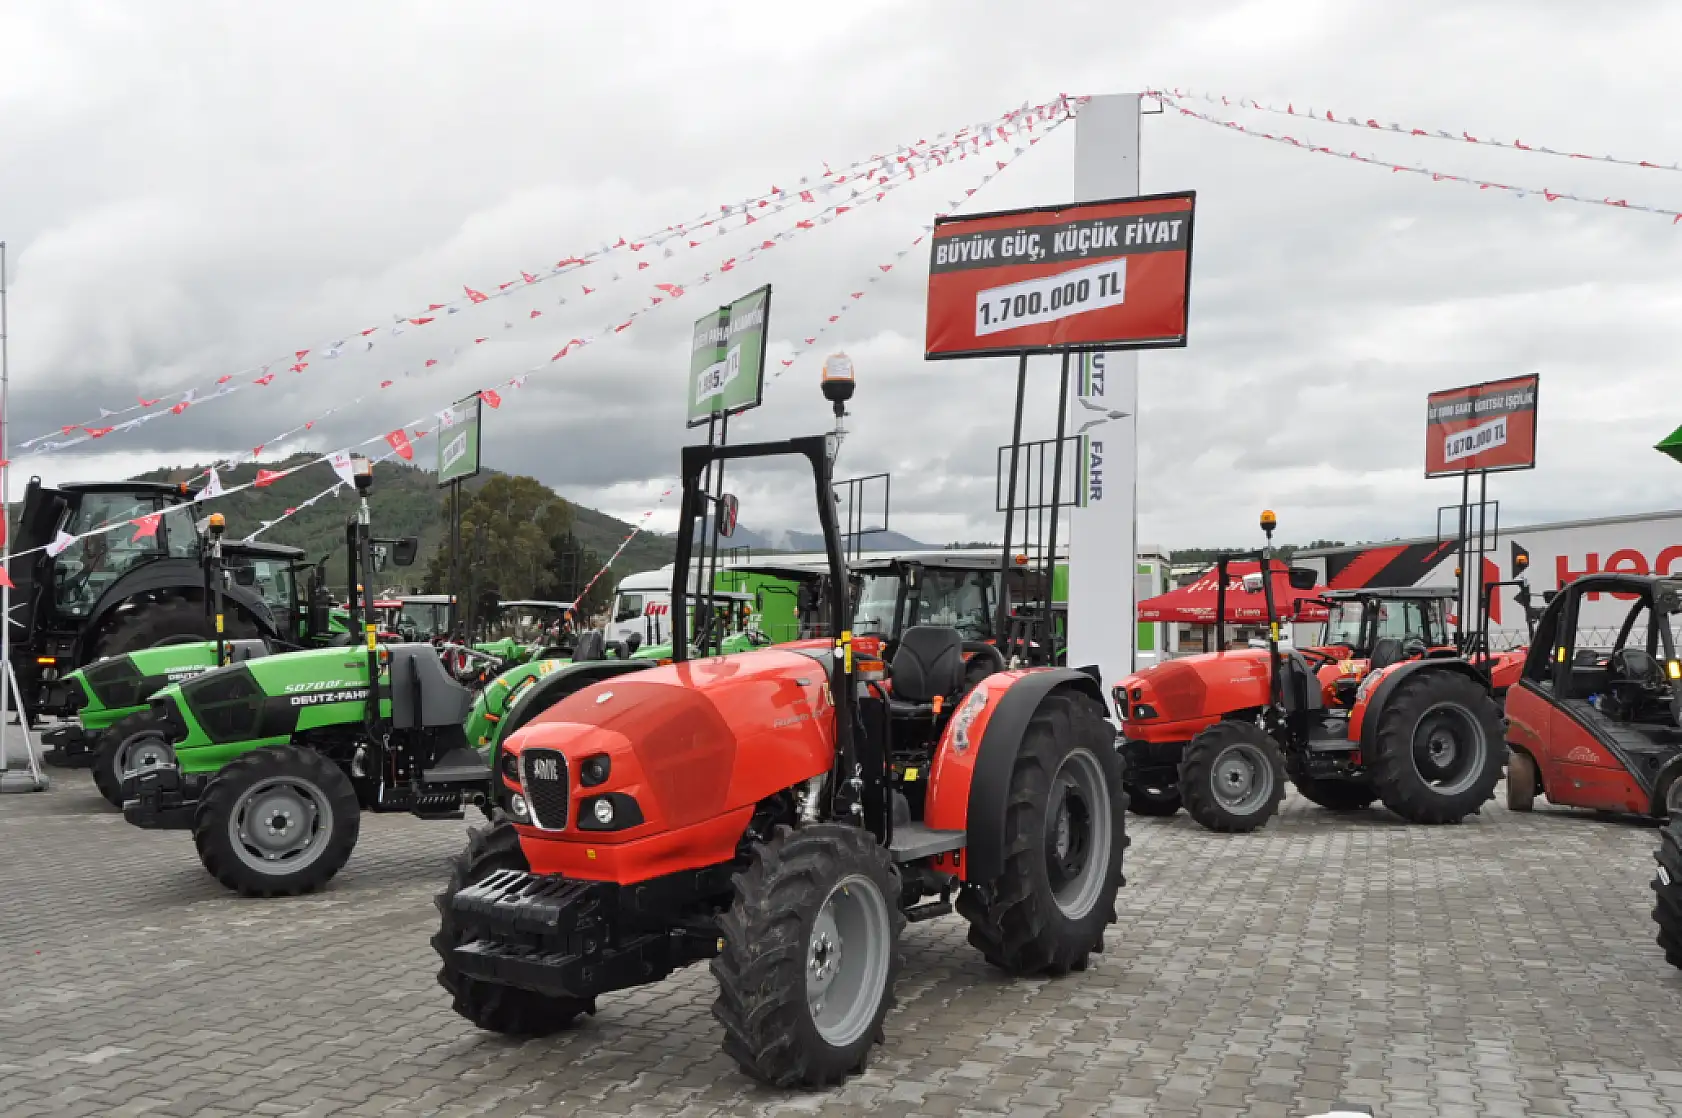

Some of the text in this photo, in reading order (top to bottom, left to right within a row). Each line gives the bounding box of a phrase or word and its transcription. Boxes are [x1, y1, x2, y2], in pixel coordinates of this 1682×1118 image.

[936, 217, 1183, 264] BÜYÜK GÜÇ, KÜÇÜK FİYAT
[979, 271, 1121, 325] 1.700.000 TL
[1092, 351, 1105, 396] UTZ
[1494, 423, 1505, 441] TL
[1090, 441, 1103, 501] FAHR
